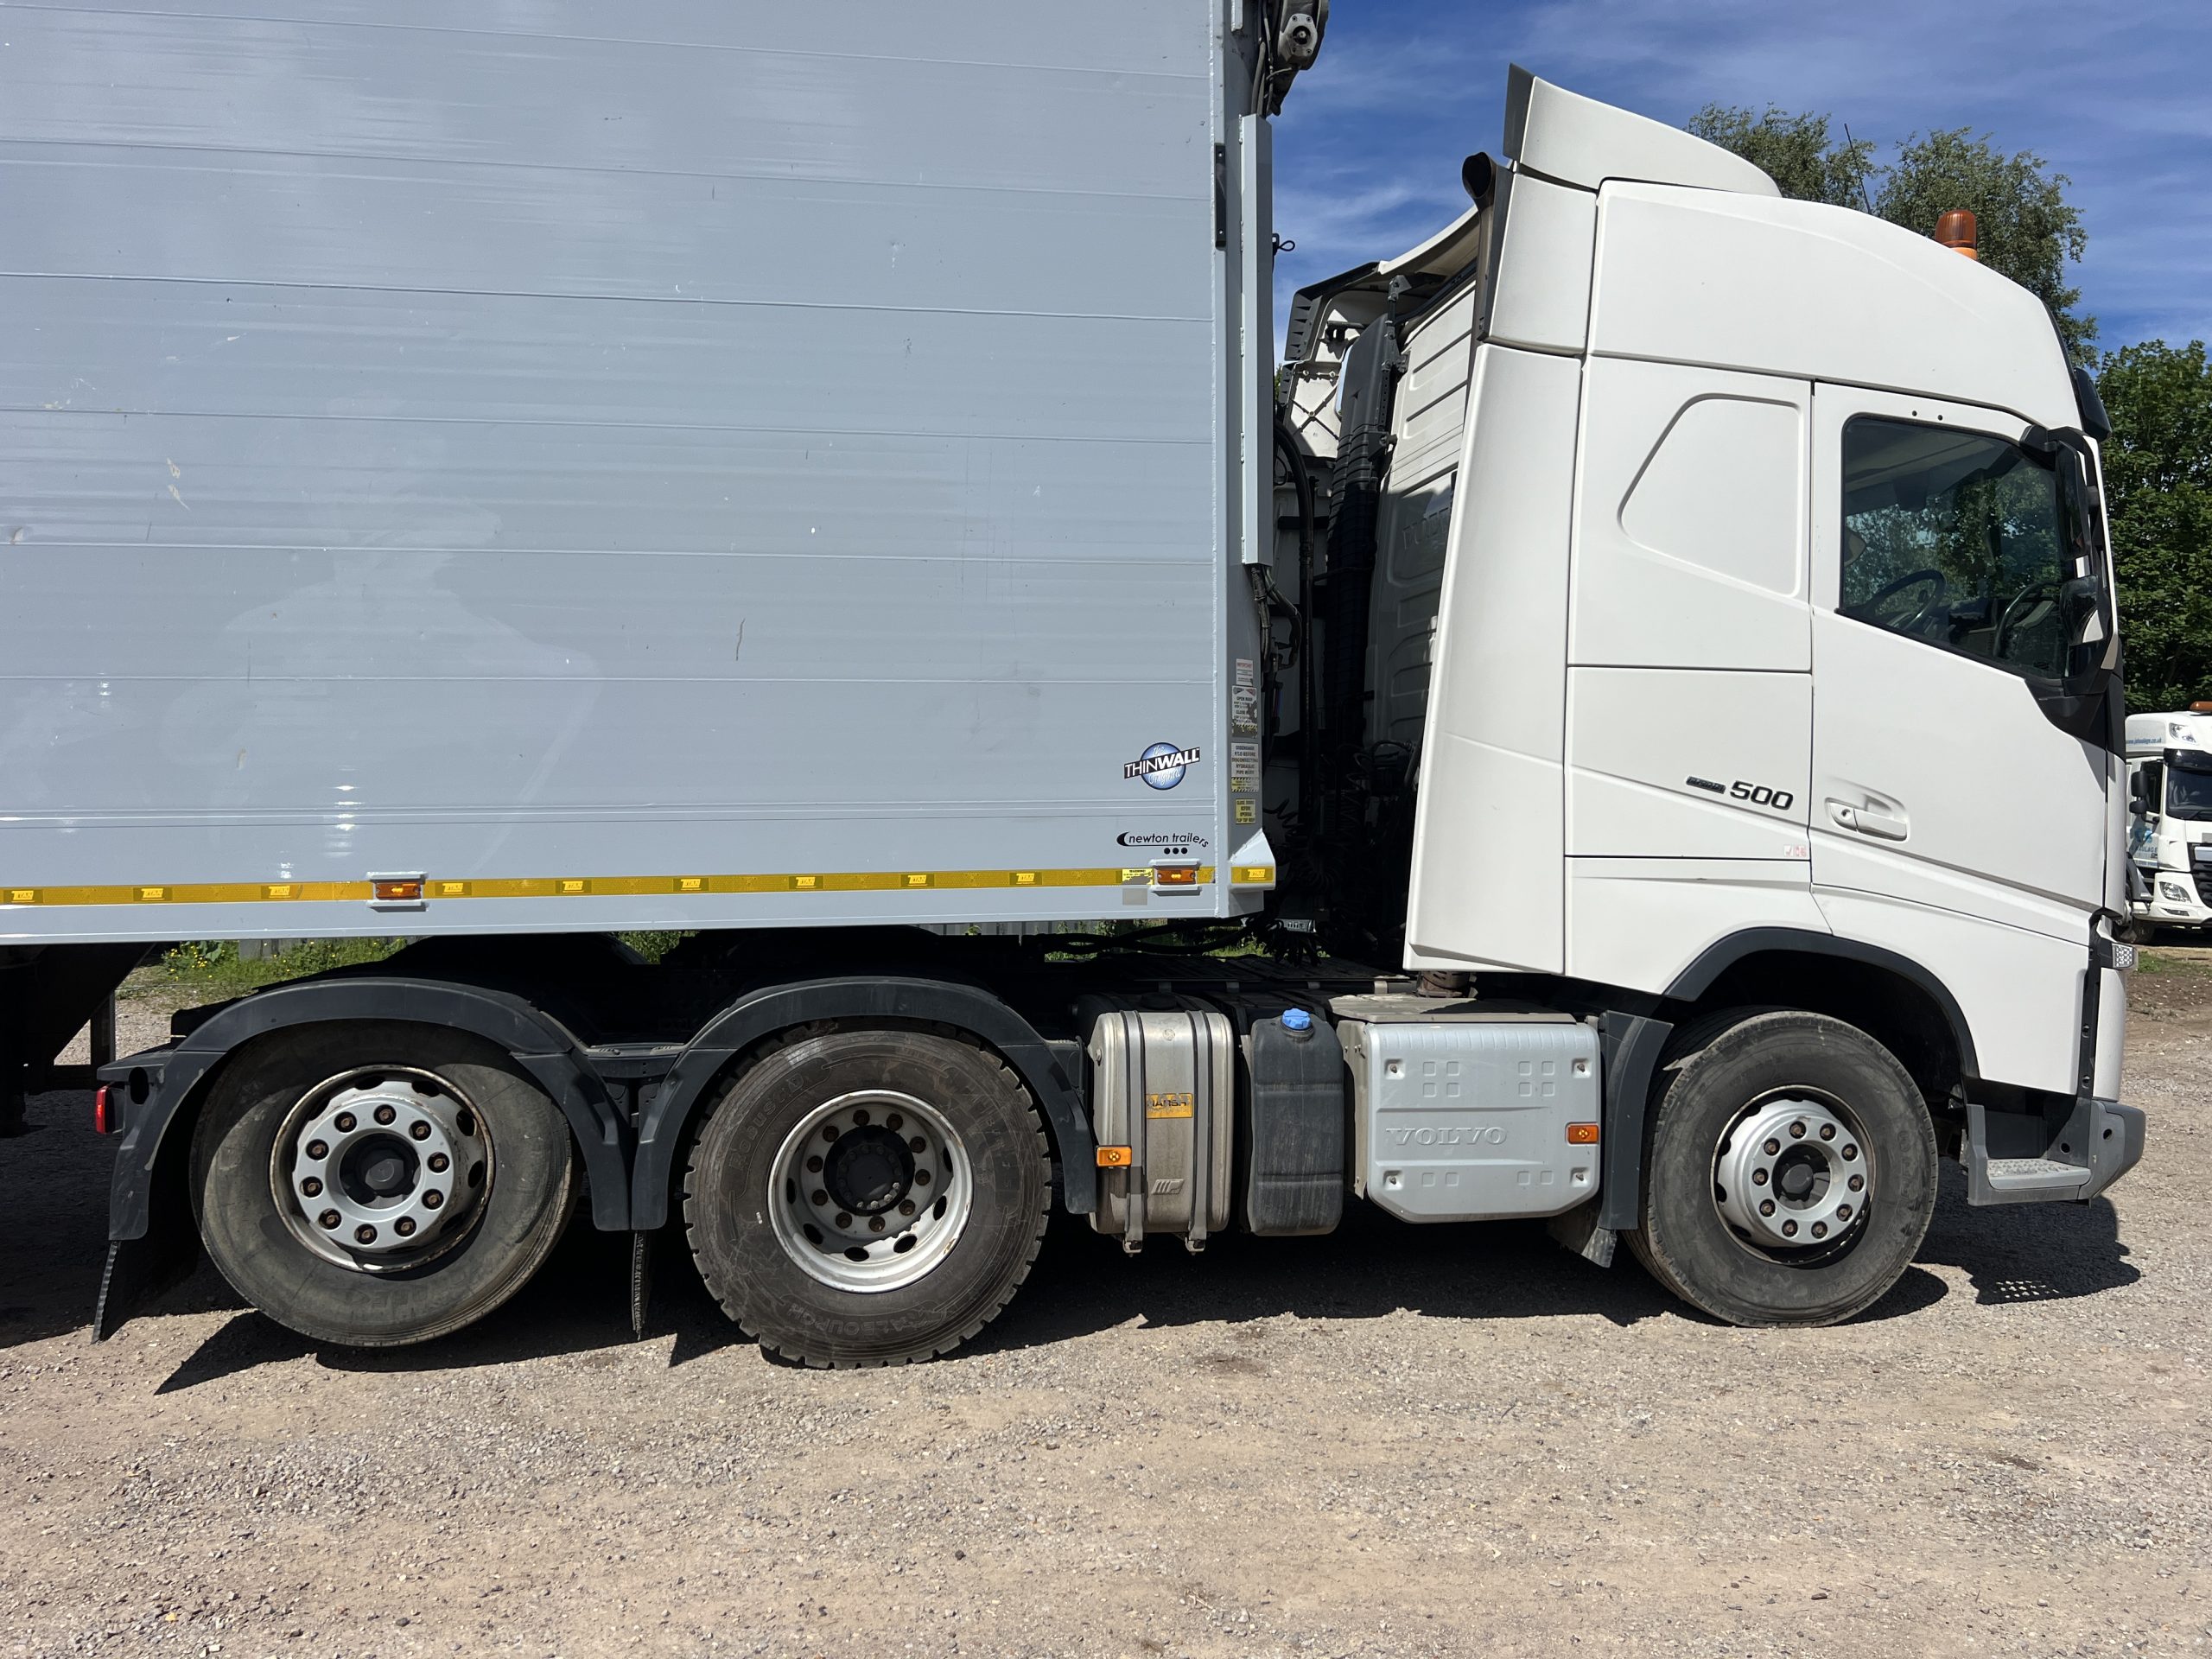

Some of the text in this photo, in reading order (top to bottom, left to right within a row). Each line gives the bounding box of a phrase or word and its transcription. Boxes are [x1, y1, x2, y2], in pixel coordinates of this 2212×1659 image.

[1124, 748, 1199, 778] THINWALL
[1730, 780, 1794, 810] 500
[1128, 832, 1209, 848] newton trailers
[1385, 1126, 1508, 1146] VOLVO
